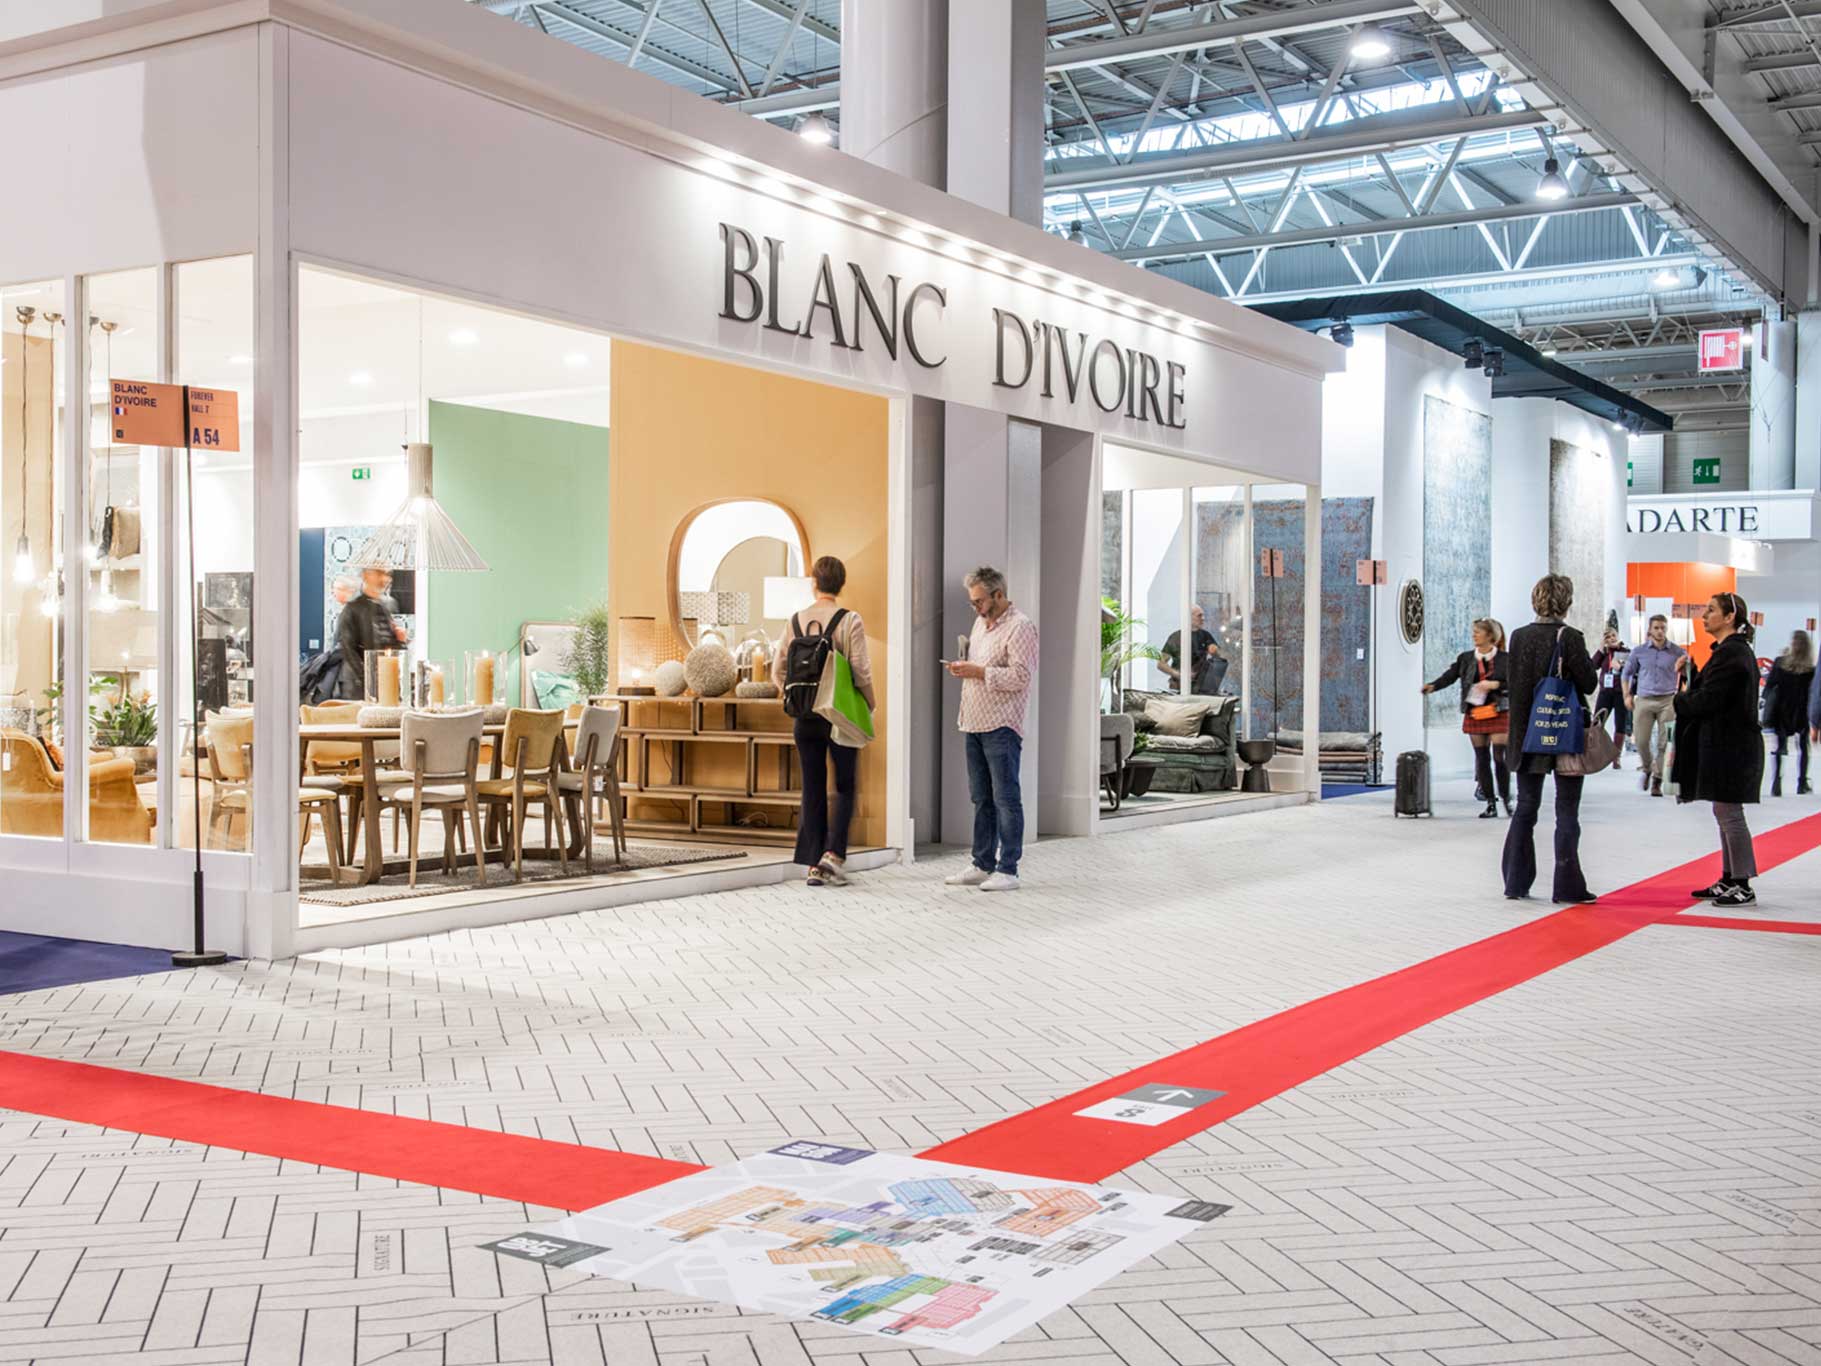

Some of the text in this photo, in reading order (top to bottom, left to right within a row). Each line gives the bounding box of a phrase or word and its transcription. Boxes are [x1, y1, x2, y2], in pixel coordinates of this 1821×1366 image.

[719, 222, 1187, 429] BLANC D'IVOIRE
[114, 383, 148, 395] BLANC
[114, 395, 157, 407] D'IVOIRE
[193, 427, 219, 445] A 54
[1627, 506, 1758, 532] DARTE
[570, 1306, 713, 1320] SIGNATURE
